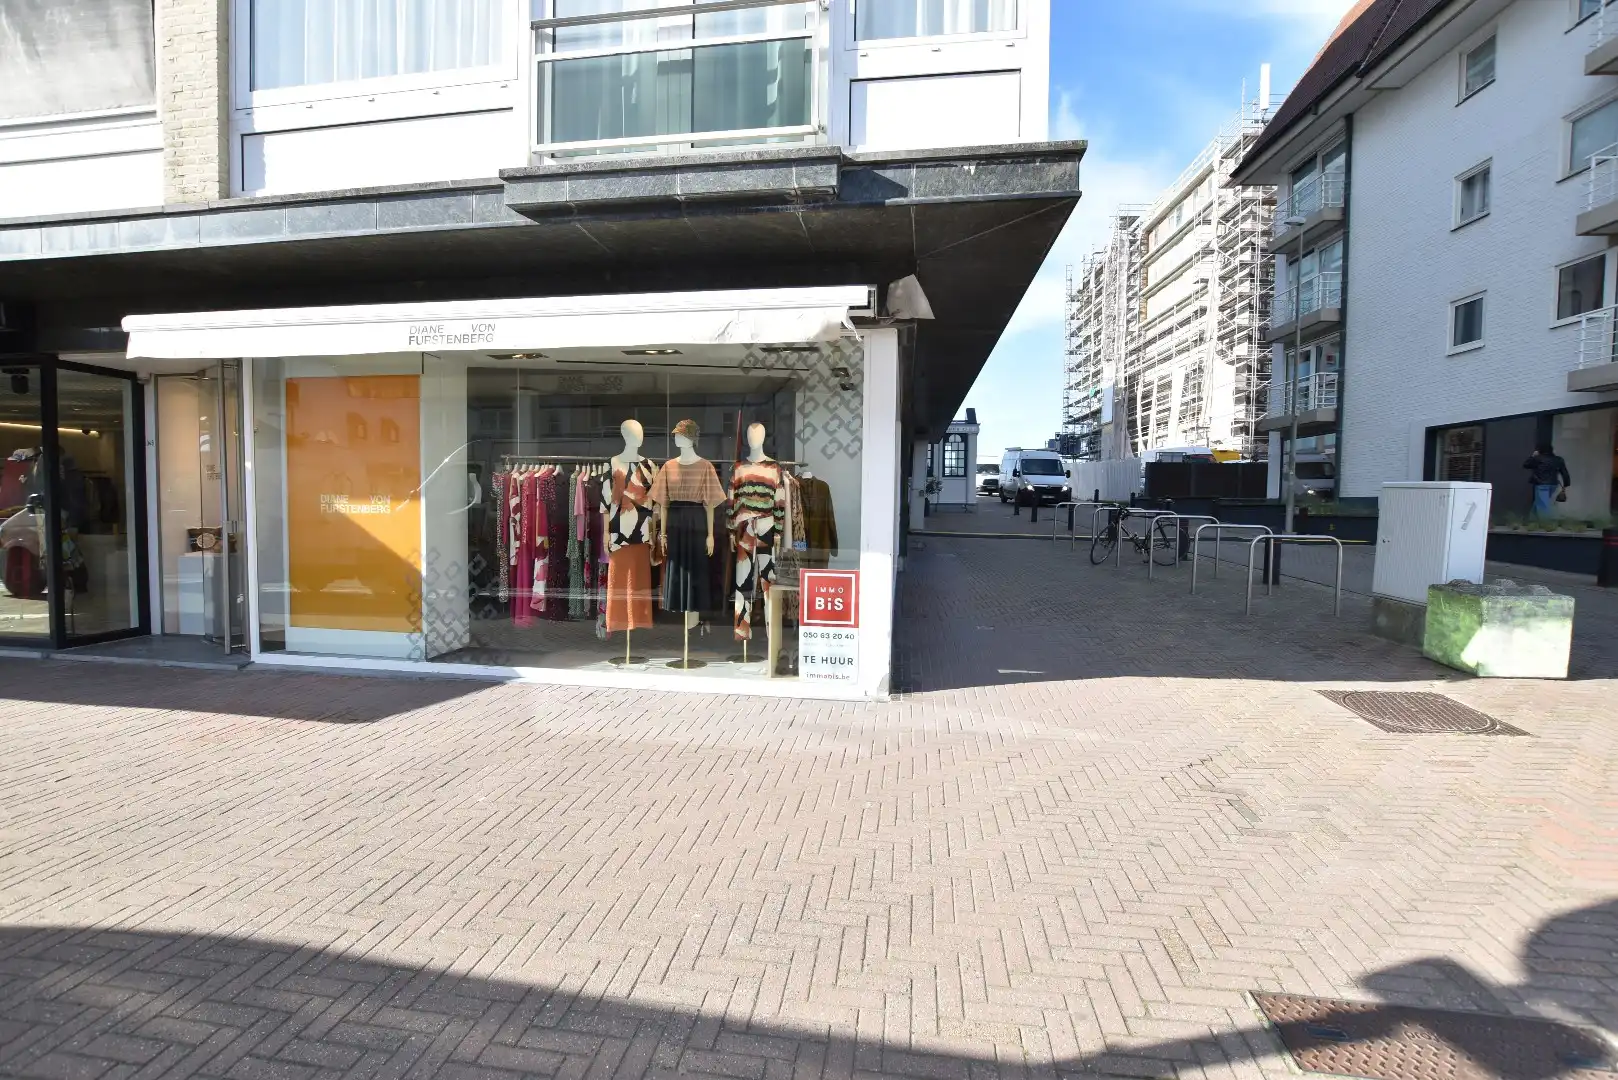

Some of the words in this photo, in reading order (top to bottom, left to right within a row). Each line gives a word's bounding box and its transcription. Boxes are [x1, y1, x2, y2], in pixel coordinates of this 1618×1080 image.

[409, 324, 445, 335] DIANE
[471, 323, 496, 333] VON
[408, 333, 494, 346] FURSTENBERG
[320, 494, 349, 504] DIANE
[369, 494, 391, 504] VON
[320, 504, 391, 514] FURSTENBERG
[803, 631, 818, 639] 050
[803, 655, 816, 664] TE
[821, 656, 854, 666] HUUR
